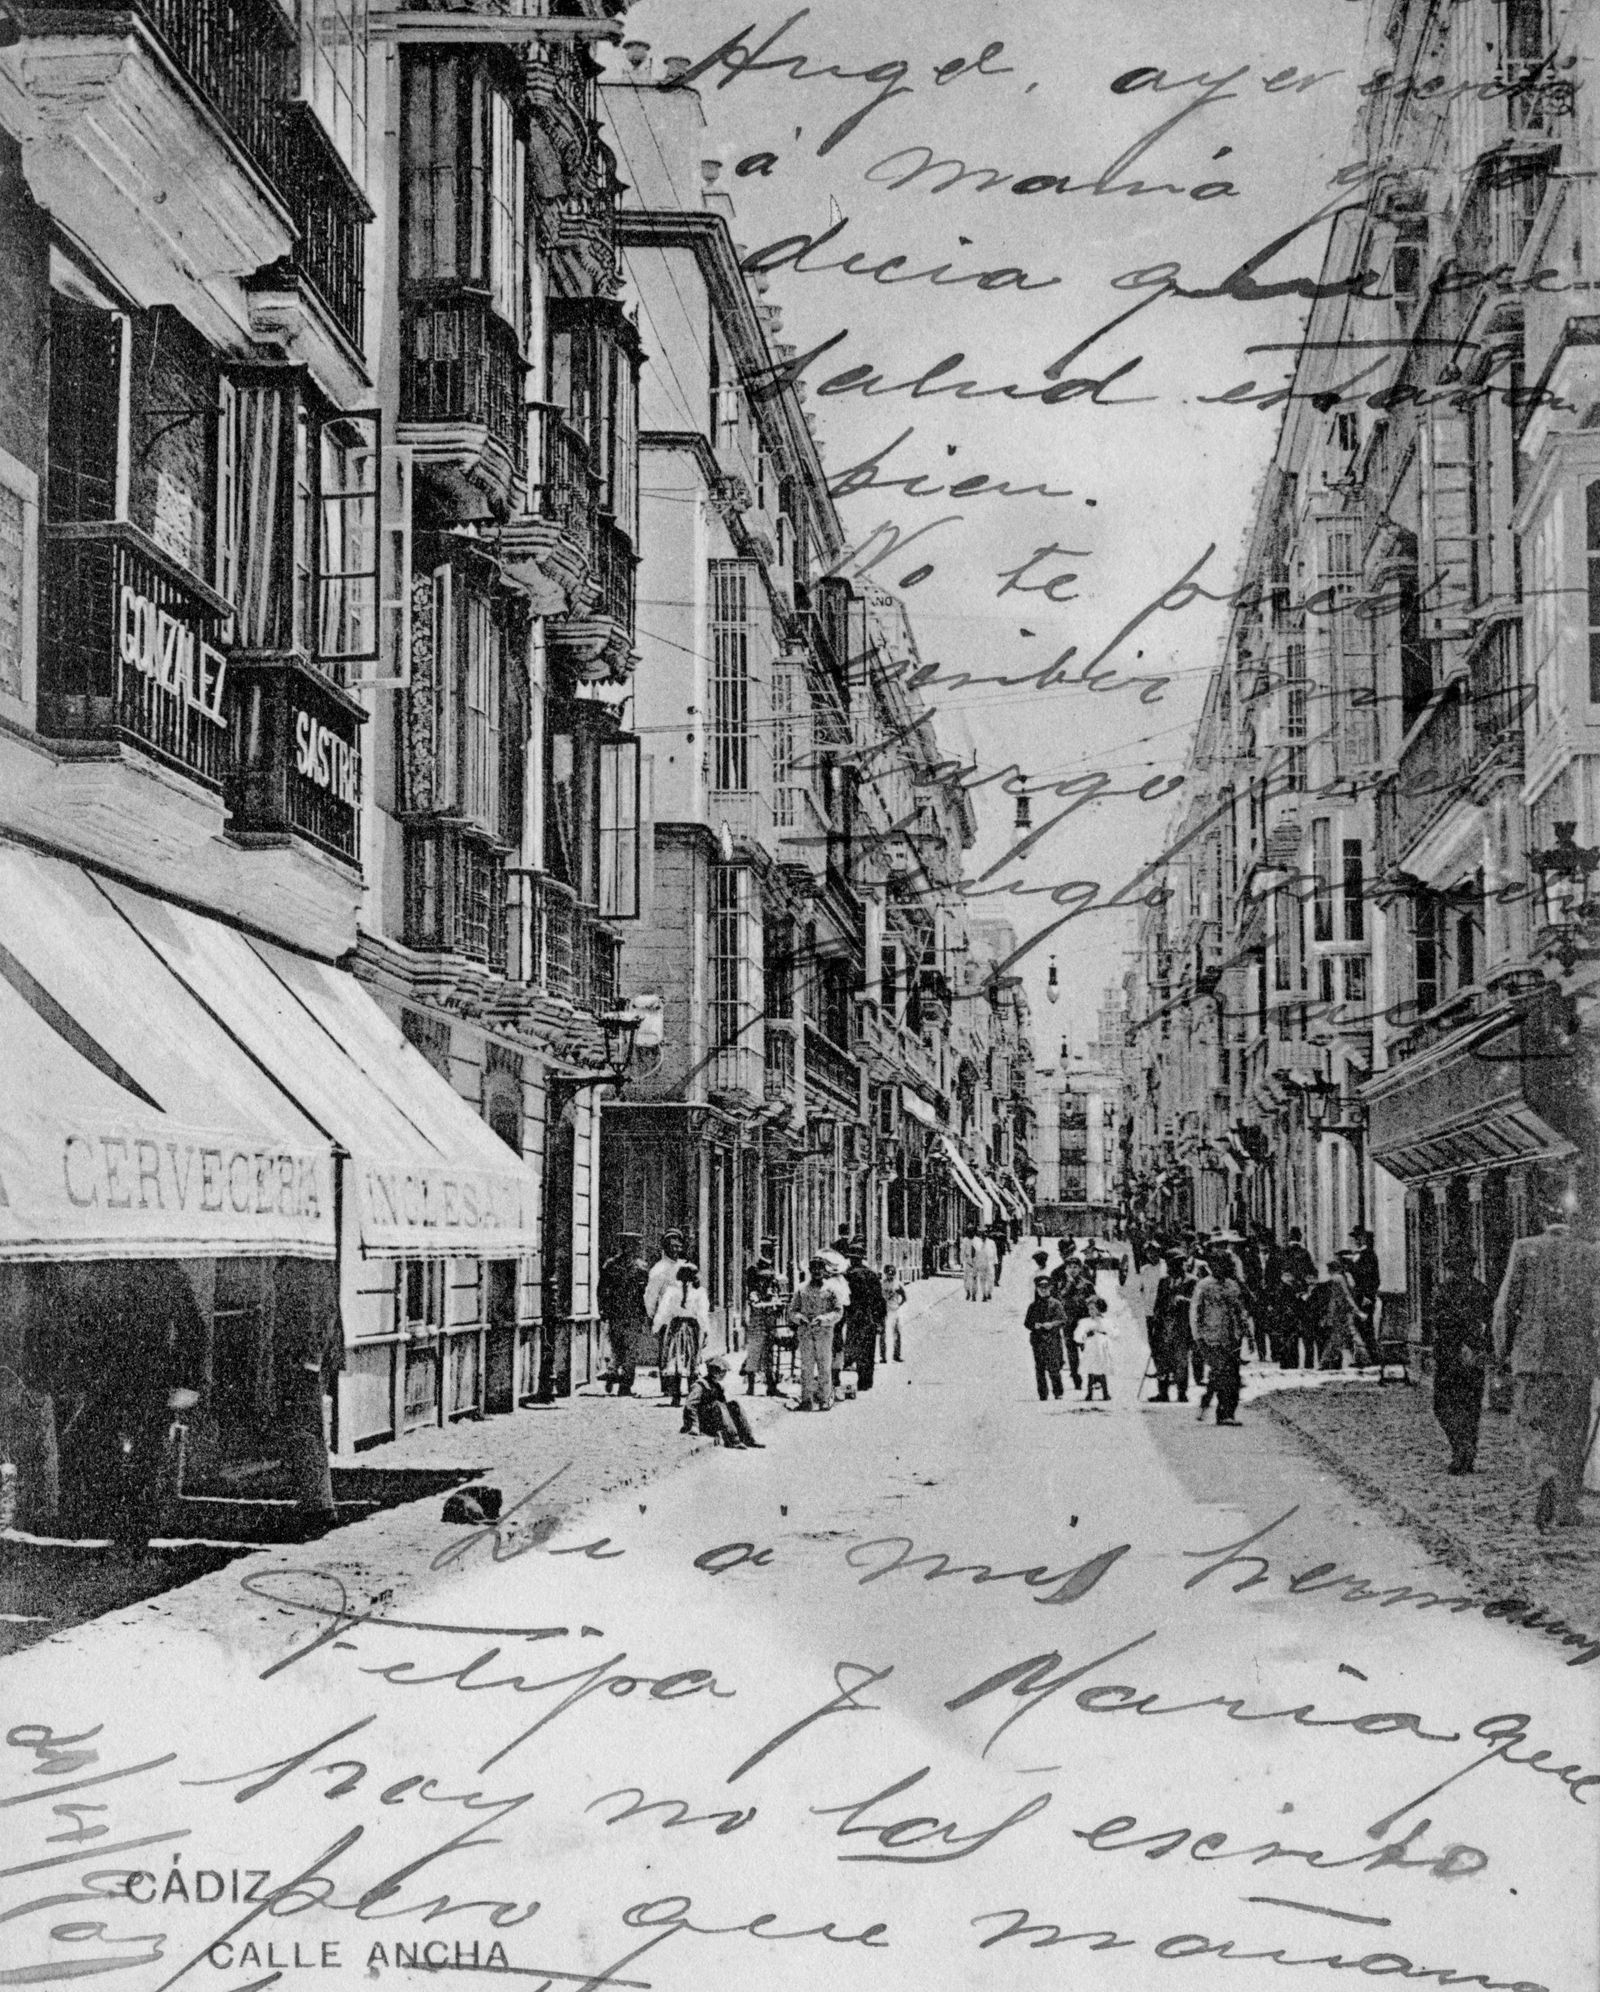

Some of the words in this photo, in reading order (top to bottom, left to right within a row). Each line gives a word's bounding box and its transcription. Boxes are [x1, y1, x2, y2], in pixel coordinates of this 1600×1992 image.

[997, 542, 1094, 602] te
[295, 710, 364, 810] SASTRE
[584, 1786, 758, 1835] no
